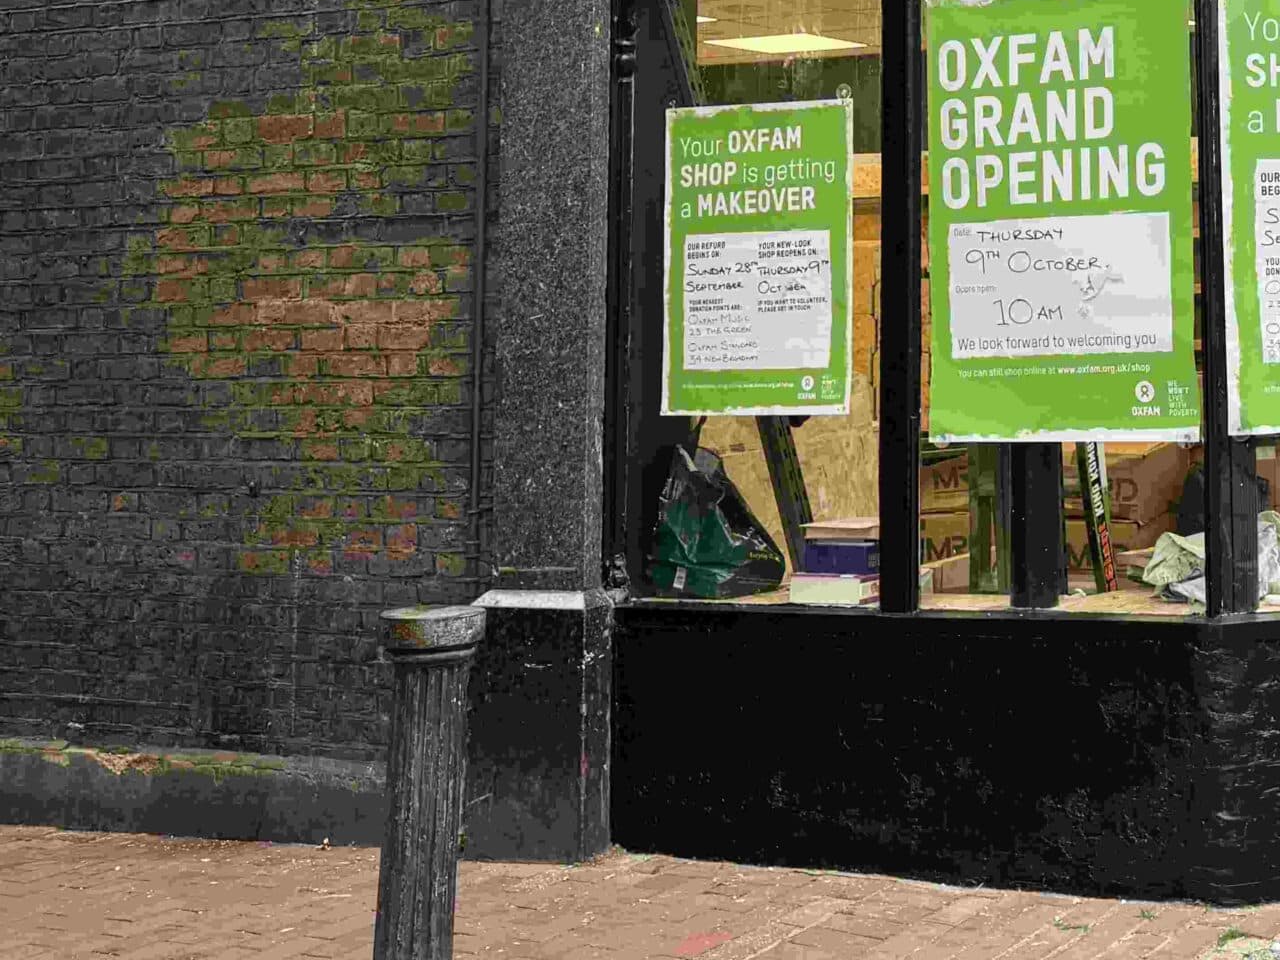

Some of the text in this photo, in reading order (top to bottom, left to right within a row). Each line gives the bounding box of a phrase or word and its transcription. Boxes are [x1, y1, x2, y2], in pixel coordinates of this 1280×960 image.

[938, 26, 1115, 92] OXFAM
[940, 86, 1114, 151] GRAND
[1248, 110, 1263, 133] a
[680, 125, 802, 158] Your OXFAM
[680, 158, 835, 187] SHOP is getting
[942, 142, 1165, 210] OPENING
[1260, 172, 1280, 183] OUR
[681, 186, 816, 218] a MAKEOVER
[976, 227, 1065, 243] THURSDAY
[687, 242, 700, 251] OUR
[758, 241, 775, 250] YOUR
[758, 250, 775, 259] SHOP
[965, 249, 1000, 274] 9TH
[686, 263, 732, 276] SUNDAY
[757, 266, 808, 277] THURSDAY
[684, 281, 744, 293] SEPTEMBER
[992, 298, 1064, 326] 10 AM
[958, 333, 1157, 351] We look forward to welcoming you
[959, 369, 972, 377] You
[974, 369, 988, 377] can
[989, 368, 1004, 376] still
[1004, 367, 1022, 377] shop
[1023, 366, 1047, 375] online
[1048, 367, 1056, 375] at
[1131, 406, 1160, 416] OXFAM
